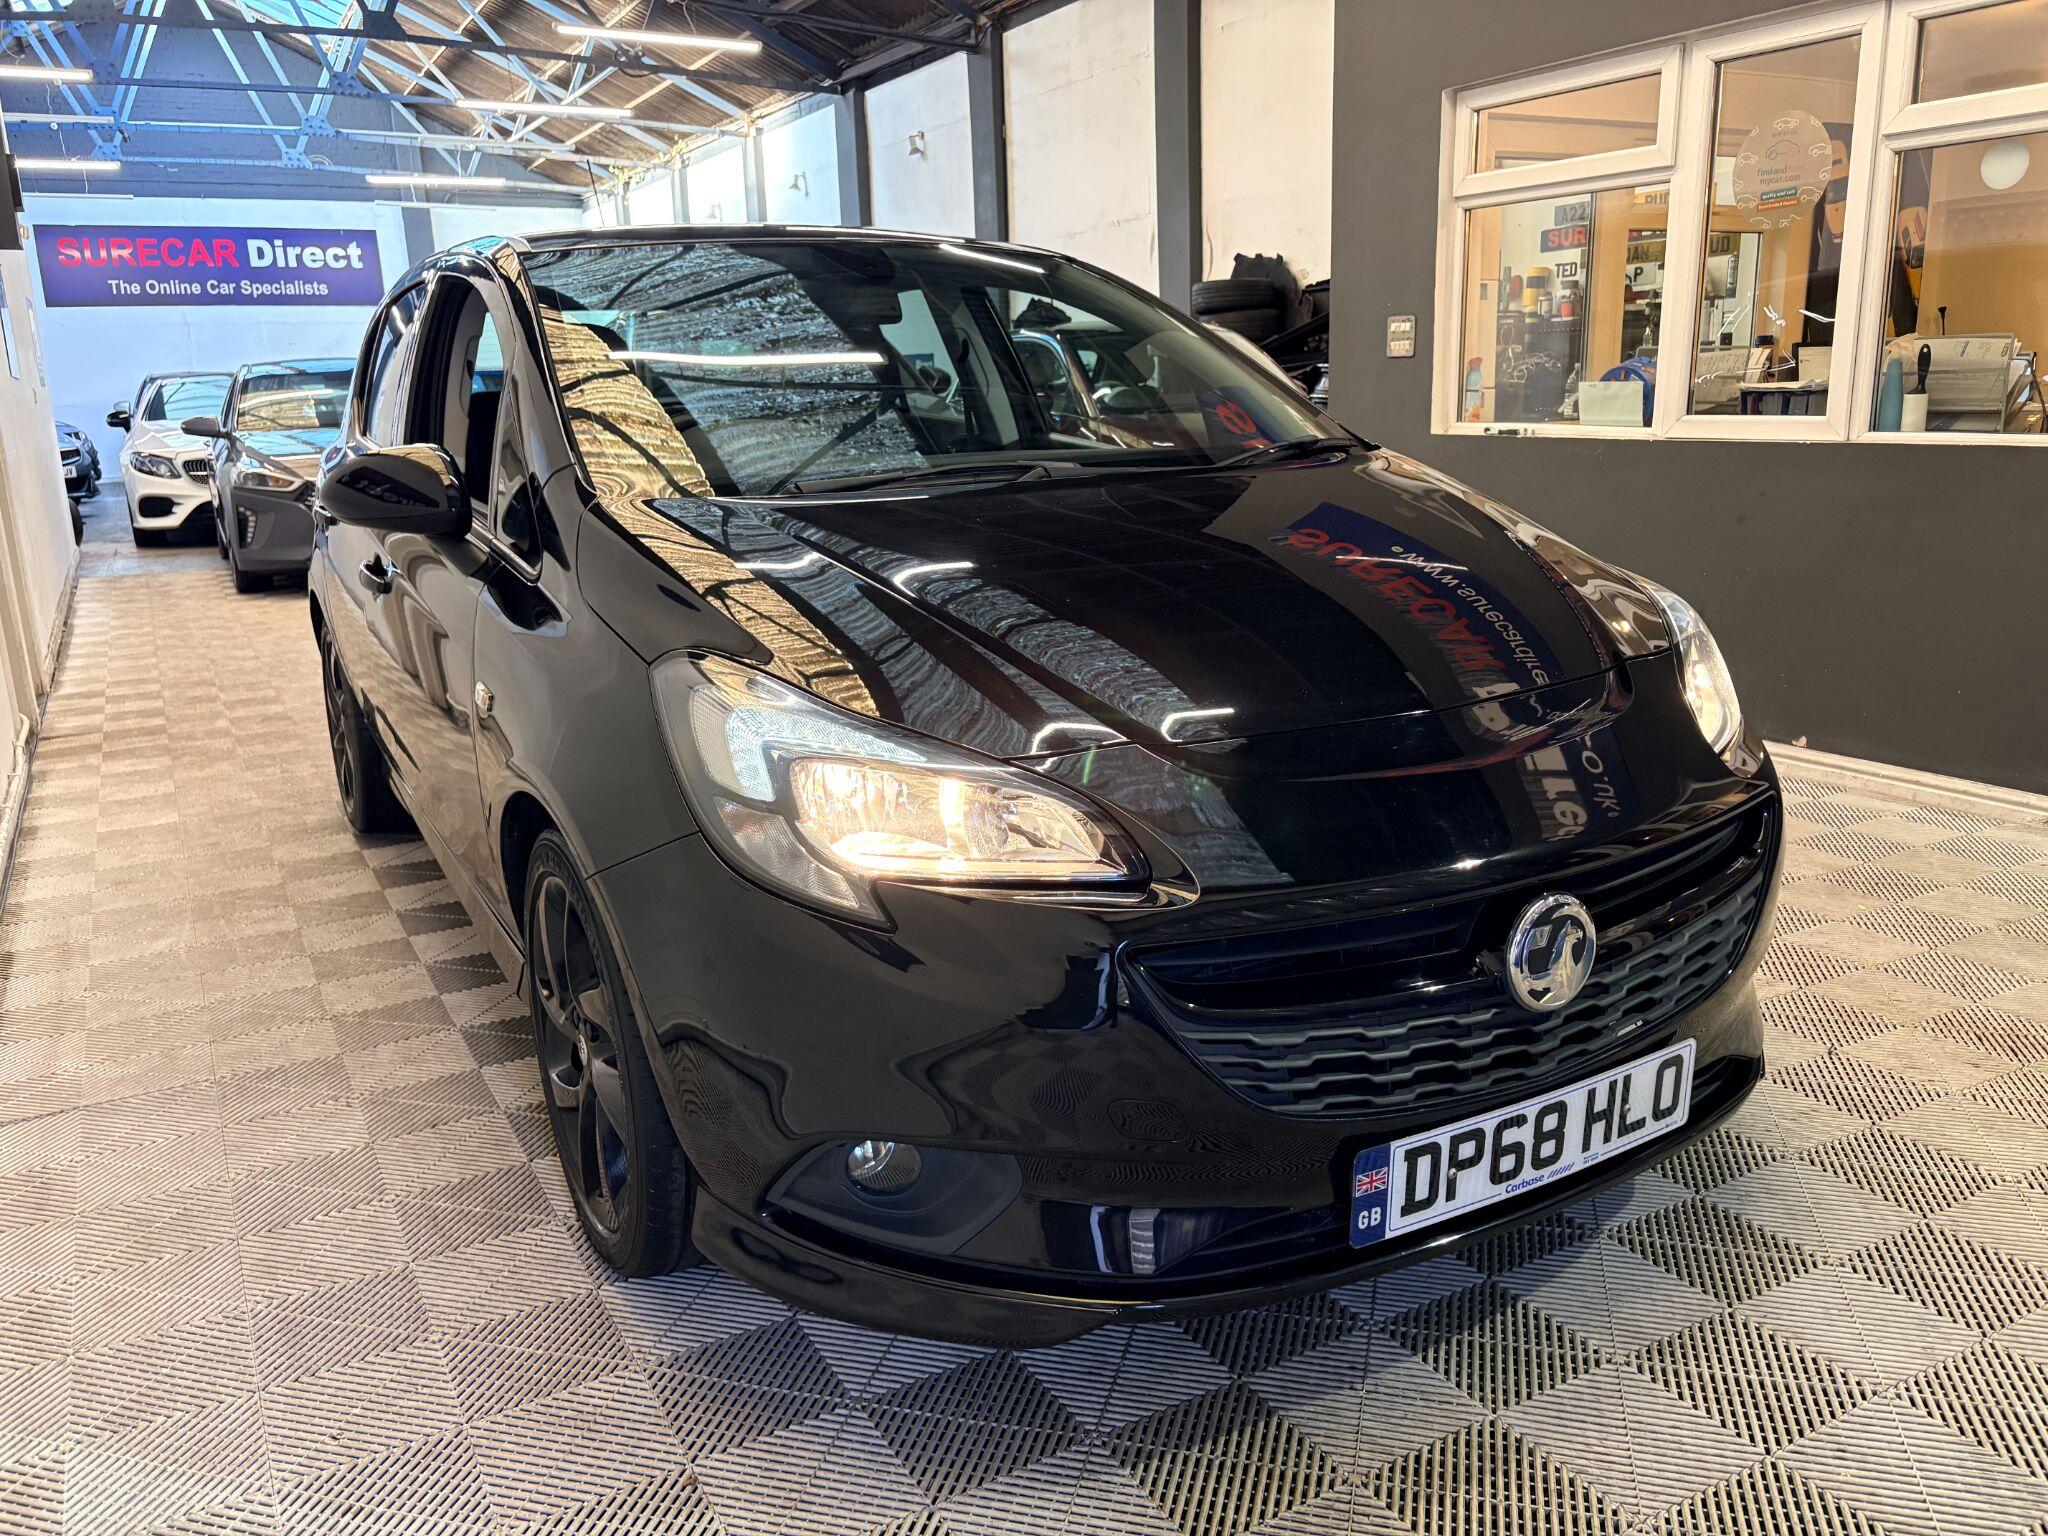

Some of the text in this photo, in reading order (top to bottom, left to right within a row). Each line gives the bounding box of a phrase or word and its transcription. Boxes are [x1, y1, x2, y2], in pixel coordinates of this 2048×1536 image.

[57, 237, 364, 270] SURECAR Direct
[1555, 262, 1578, 278] TED
[108, 280, 329, 298] The Online Car Specialists
[1400, 1053, 1684, 1219] DP68 HLO
[1505, 1173, 1545, 1195] Carbase
[1357, 1206, 1382, 1231] GB
